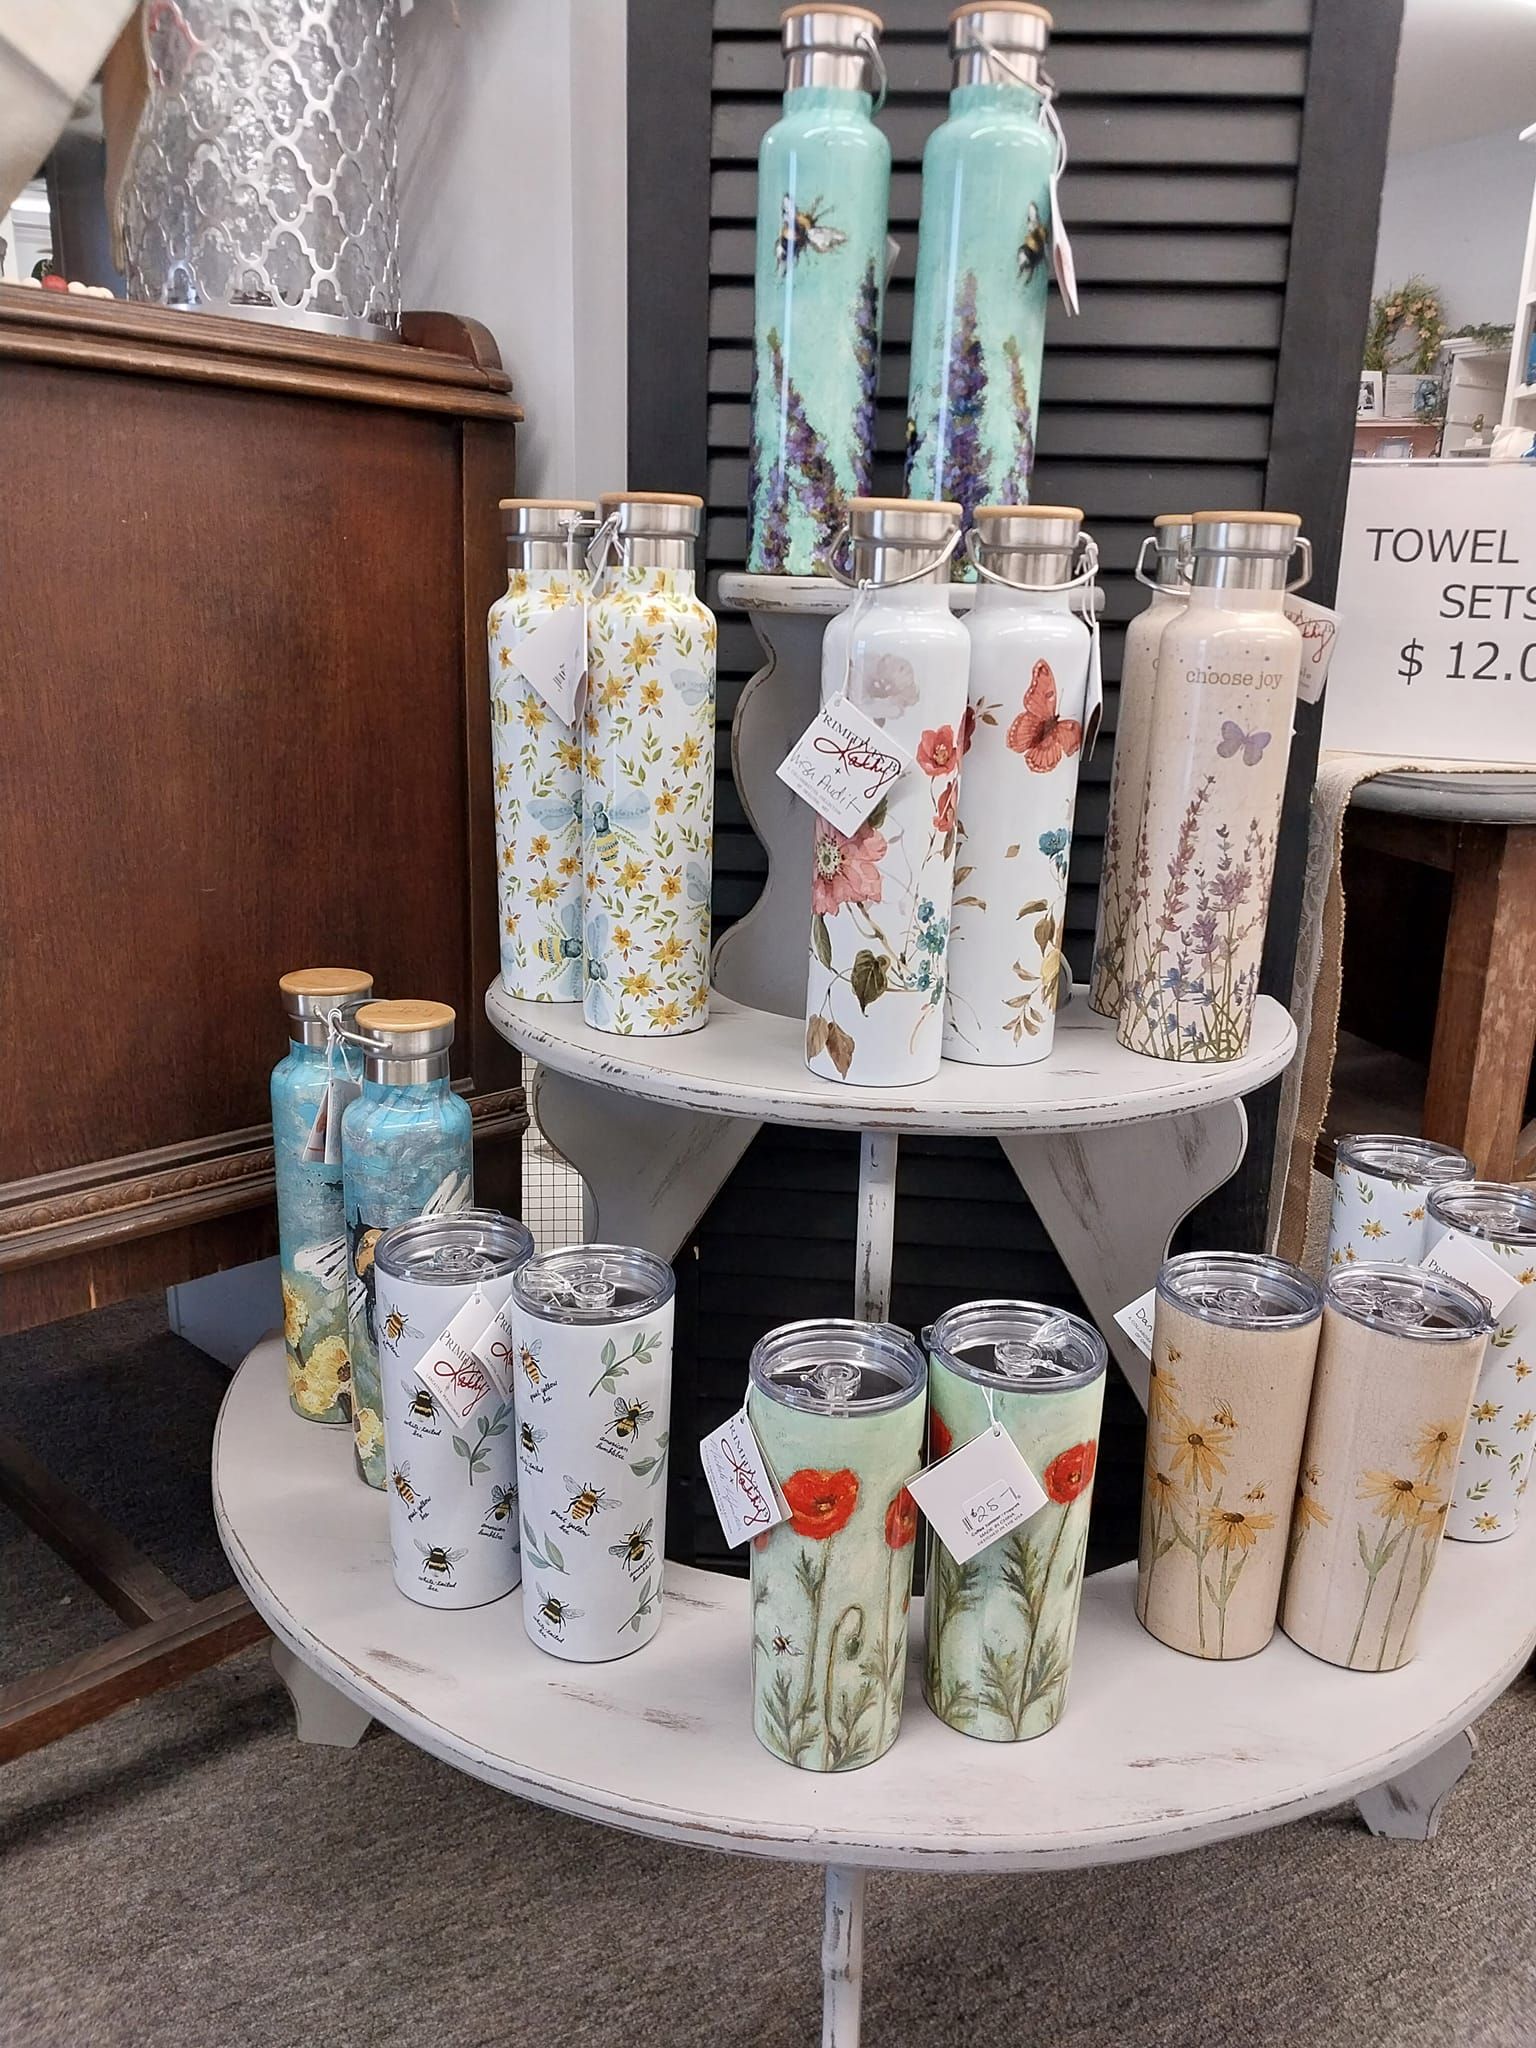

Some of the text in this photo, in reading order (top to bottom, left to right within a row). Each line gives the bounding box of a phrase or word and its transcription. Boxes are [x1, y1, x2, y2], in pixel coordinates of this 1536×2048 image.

[1366, 528, 1519, 563] TOWEL
[1186, 668, 1253, 686] choose
[1255, 672, 1282, 690] joy
[1398, 638, 1424, 685] $
